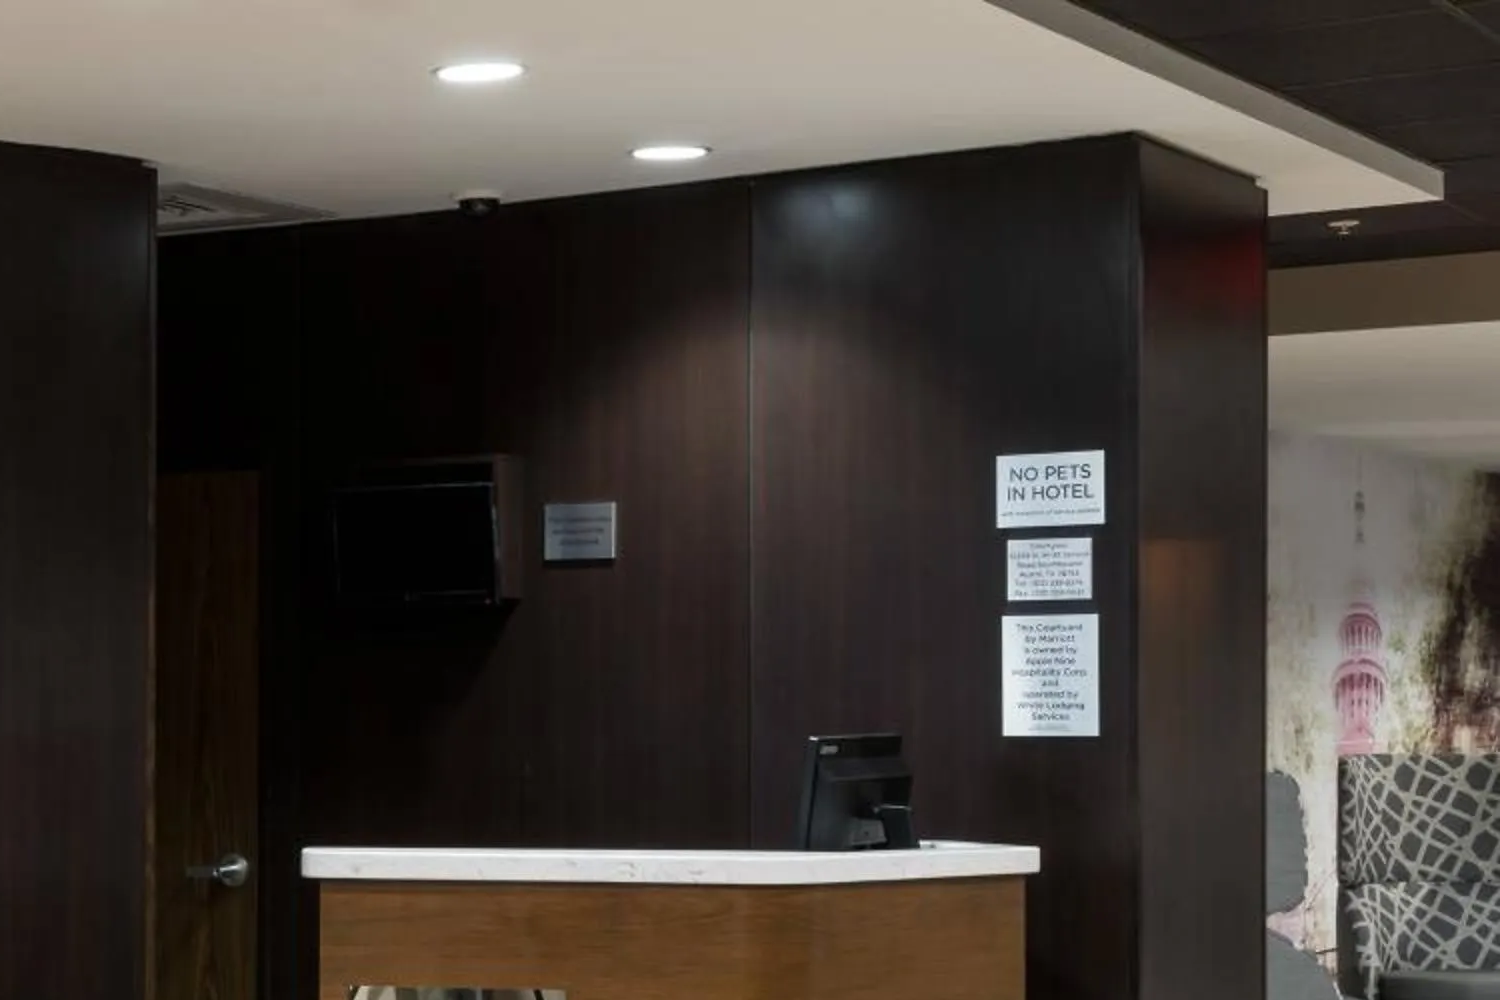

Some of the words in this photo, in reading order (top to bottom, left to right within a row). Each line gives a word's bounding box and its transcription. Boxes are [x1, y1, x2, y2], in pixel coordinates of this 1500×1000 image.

[1009, 466, 1039, 482] NO
[1045, 463, 1091, 480] PETS
[1007, 486, 1025, 501] IN
[1031, 483, 1095, 500] HOTEL
[1025, 635, 1036, 644] by
[1039, 634, 1075, 642] Marriott
[1031, 646, 1063, 654] owned
